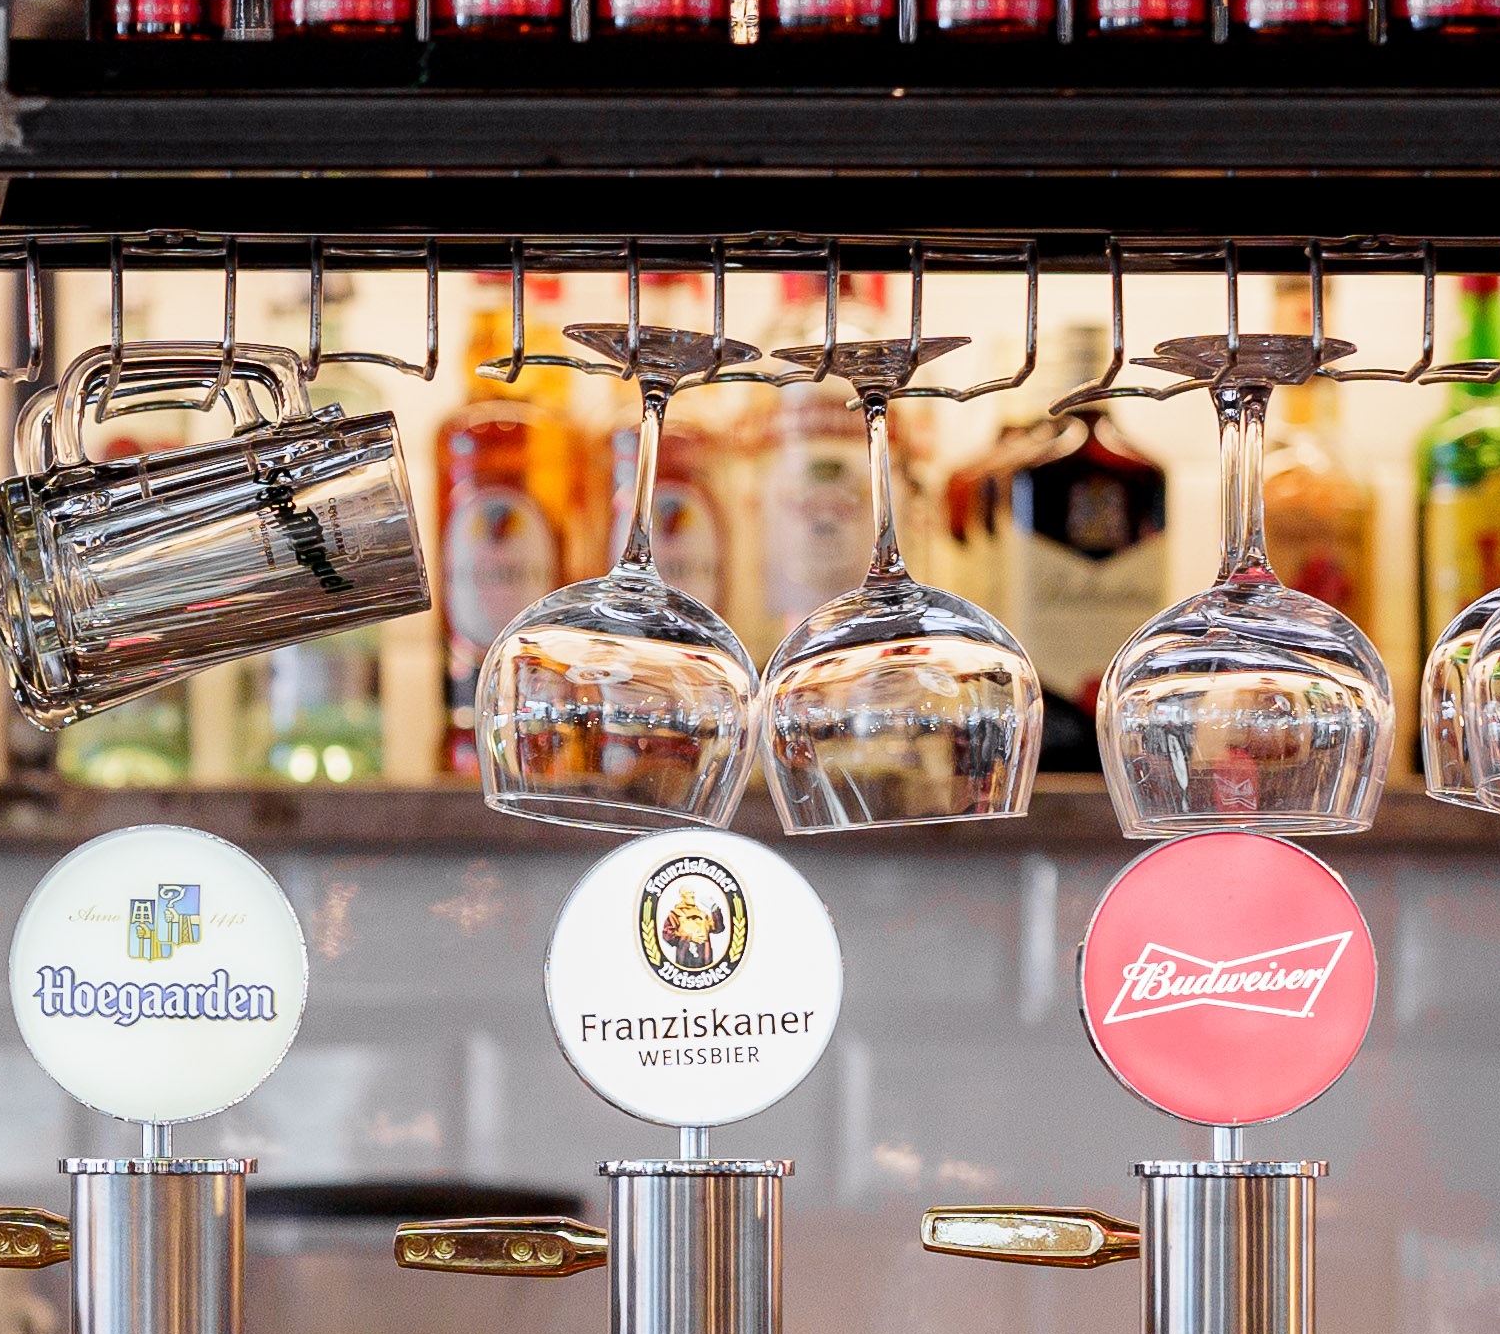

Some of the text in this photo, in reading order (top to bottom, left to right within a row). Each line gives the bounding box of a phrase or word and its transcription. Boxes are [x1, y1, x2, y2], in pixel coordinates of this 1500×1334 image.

[646, 859, 739, 896] Franziskaner
[657, 961, 731, 989] Weissbier
[1122, 960, 1325, 1001] Budweiser
[33, 965, 278, 1027] Hoegaarden
[581, 1007, 815, 1042] Franziskaner
[639, 1046, 760, 1066] WEISSBIER
